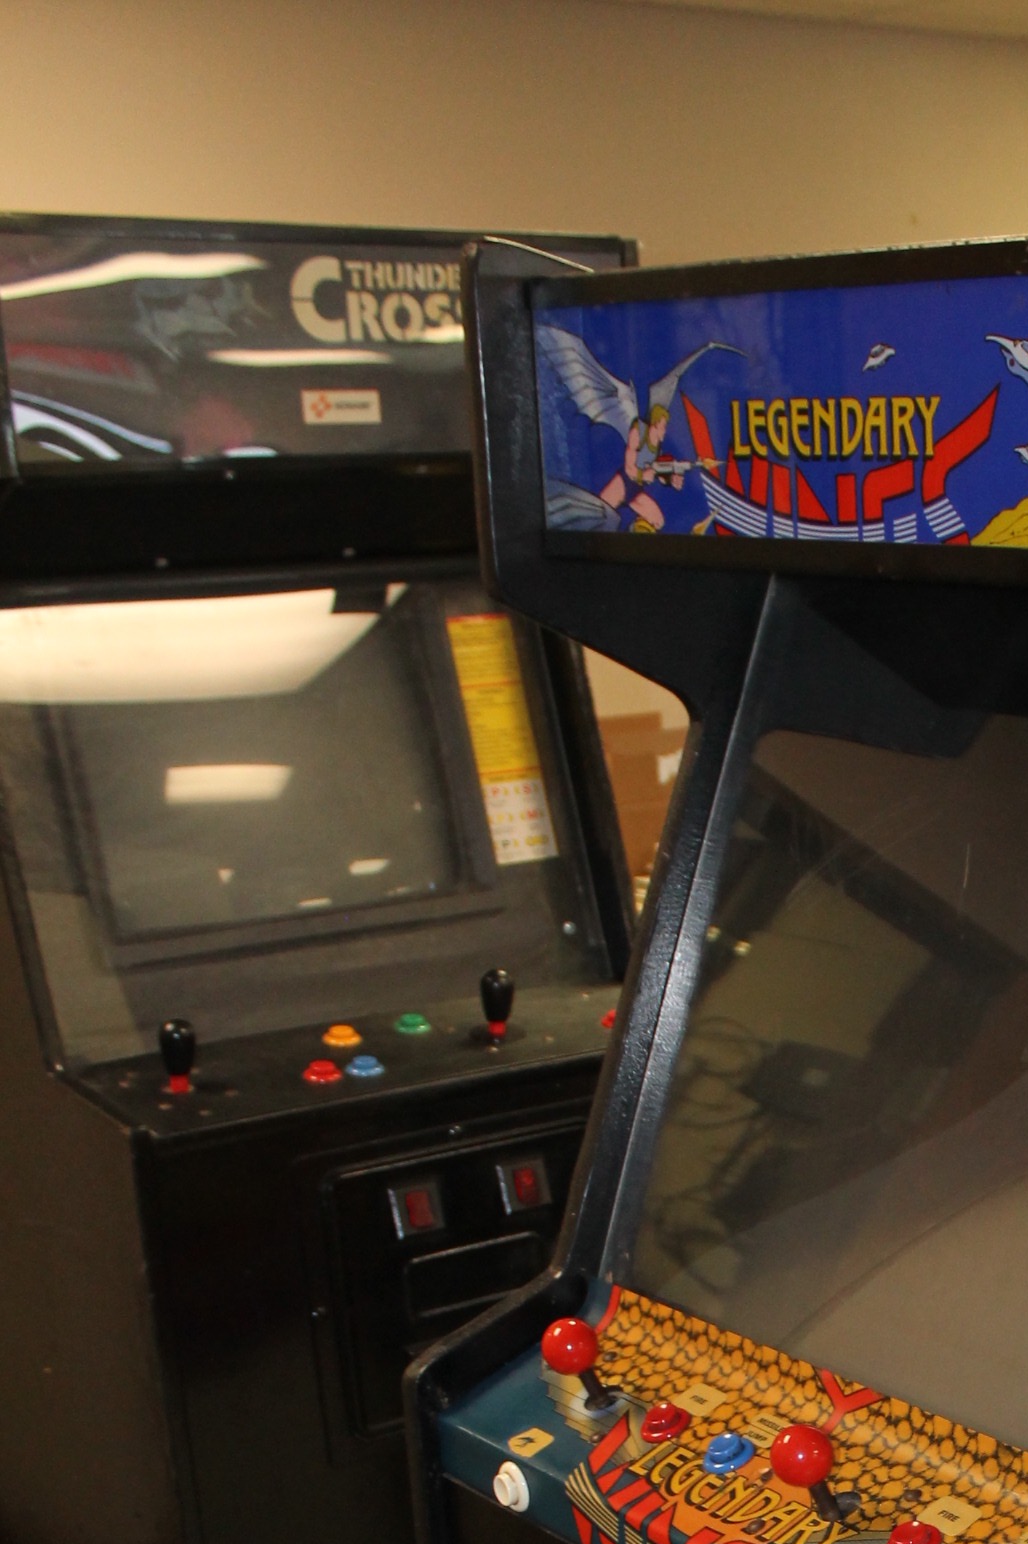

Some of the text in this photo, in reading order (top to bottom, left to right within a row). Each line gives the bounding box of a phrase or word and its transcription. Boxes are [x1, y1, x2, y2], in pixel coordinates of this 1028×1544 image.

[344, 260, 462, 290] THUNDE
[290, 255, 463, 343] CROS
[731, 395, 941, 459] LEGENDARY
[937, 1508, 961, 1523] FIRE
